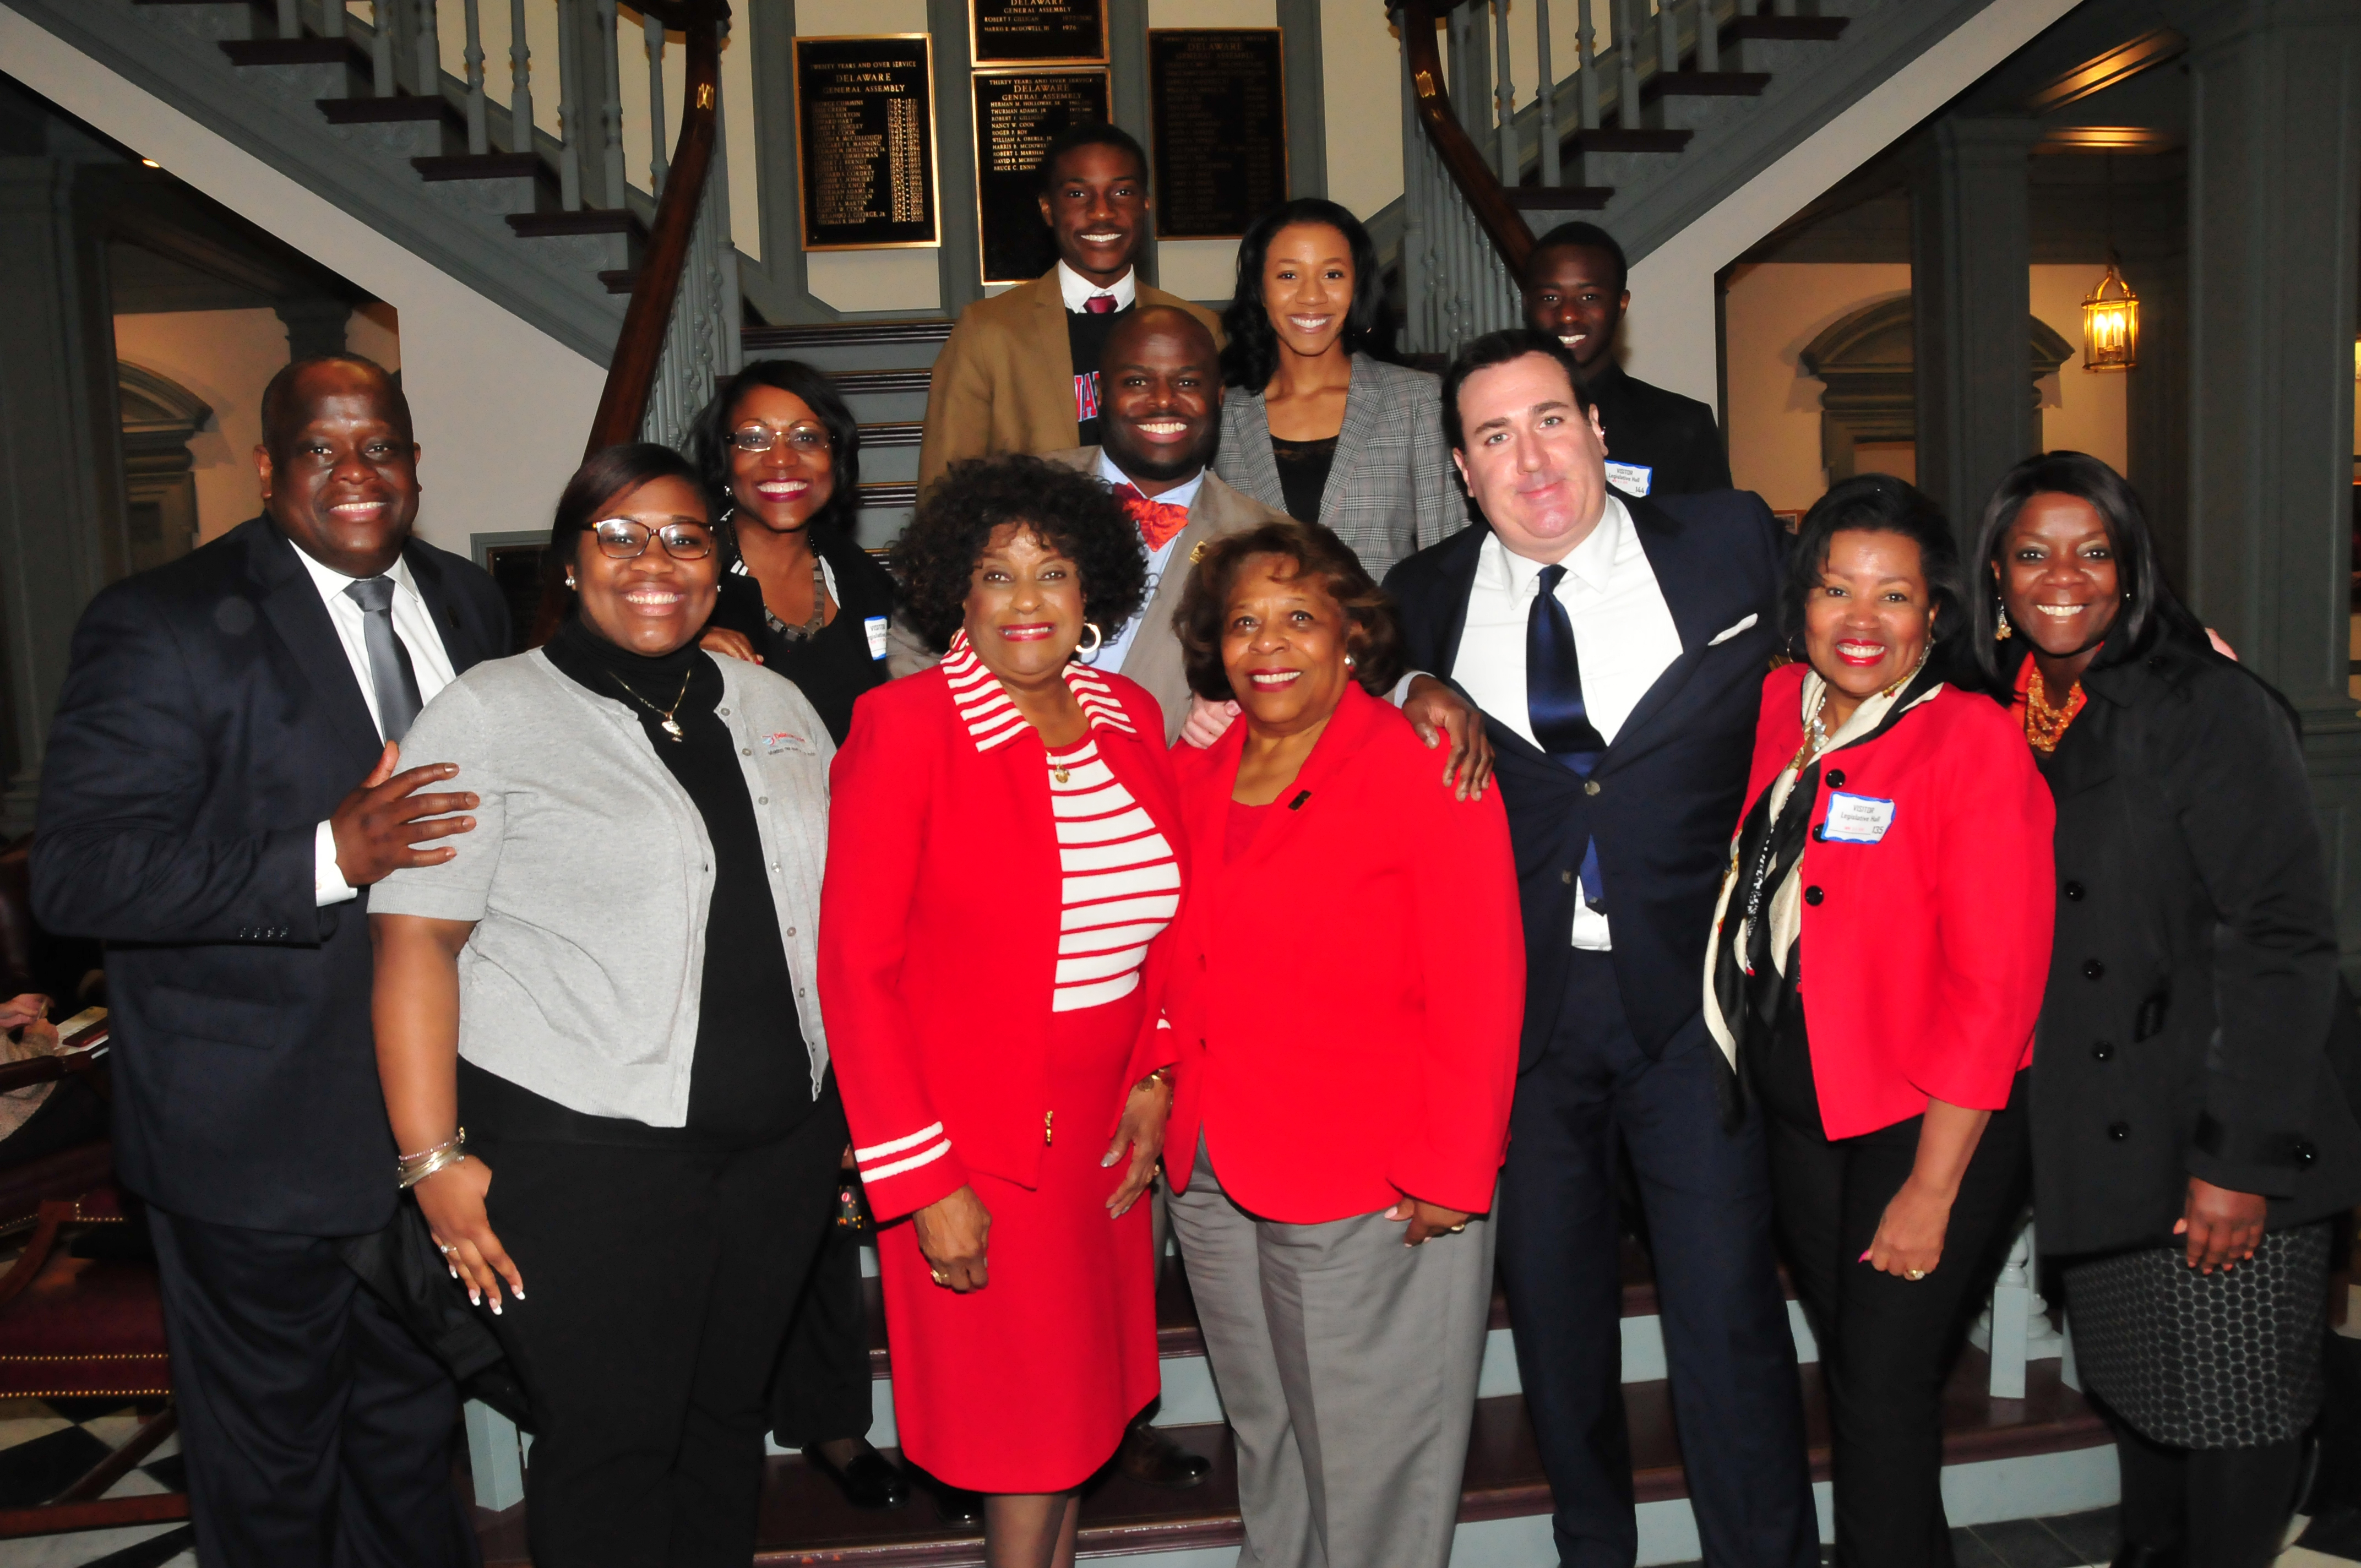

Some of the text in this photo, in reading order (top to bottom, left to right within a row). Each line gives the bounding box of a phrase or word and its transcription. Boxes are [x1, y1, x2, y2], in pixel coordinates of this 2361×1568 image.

[836, 73, 891, 83] DELAWARE
[865, 84, 905, 92] ASSEMBLY
[1014, 85, 1069, 93] DELAWARE
[1853, 804, 1875, 814] VISITOR
[1841, 812, 1869, 822] Legislative
